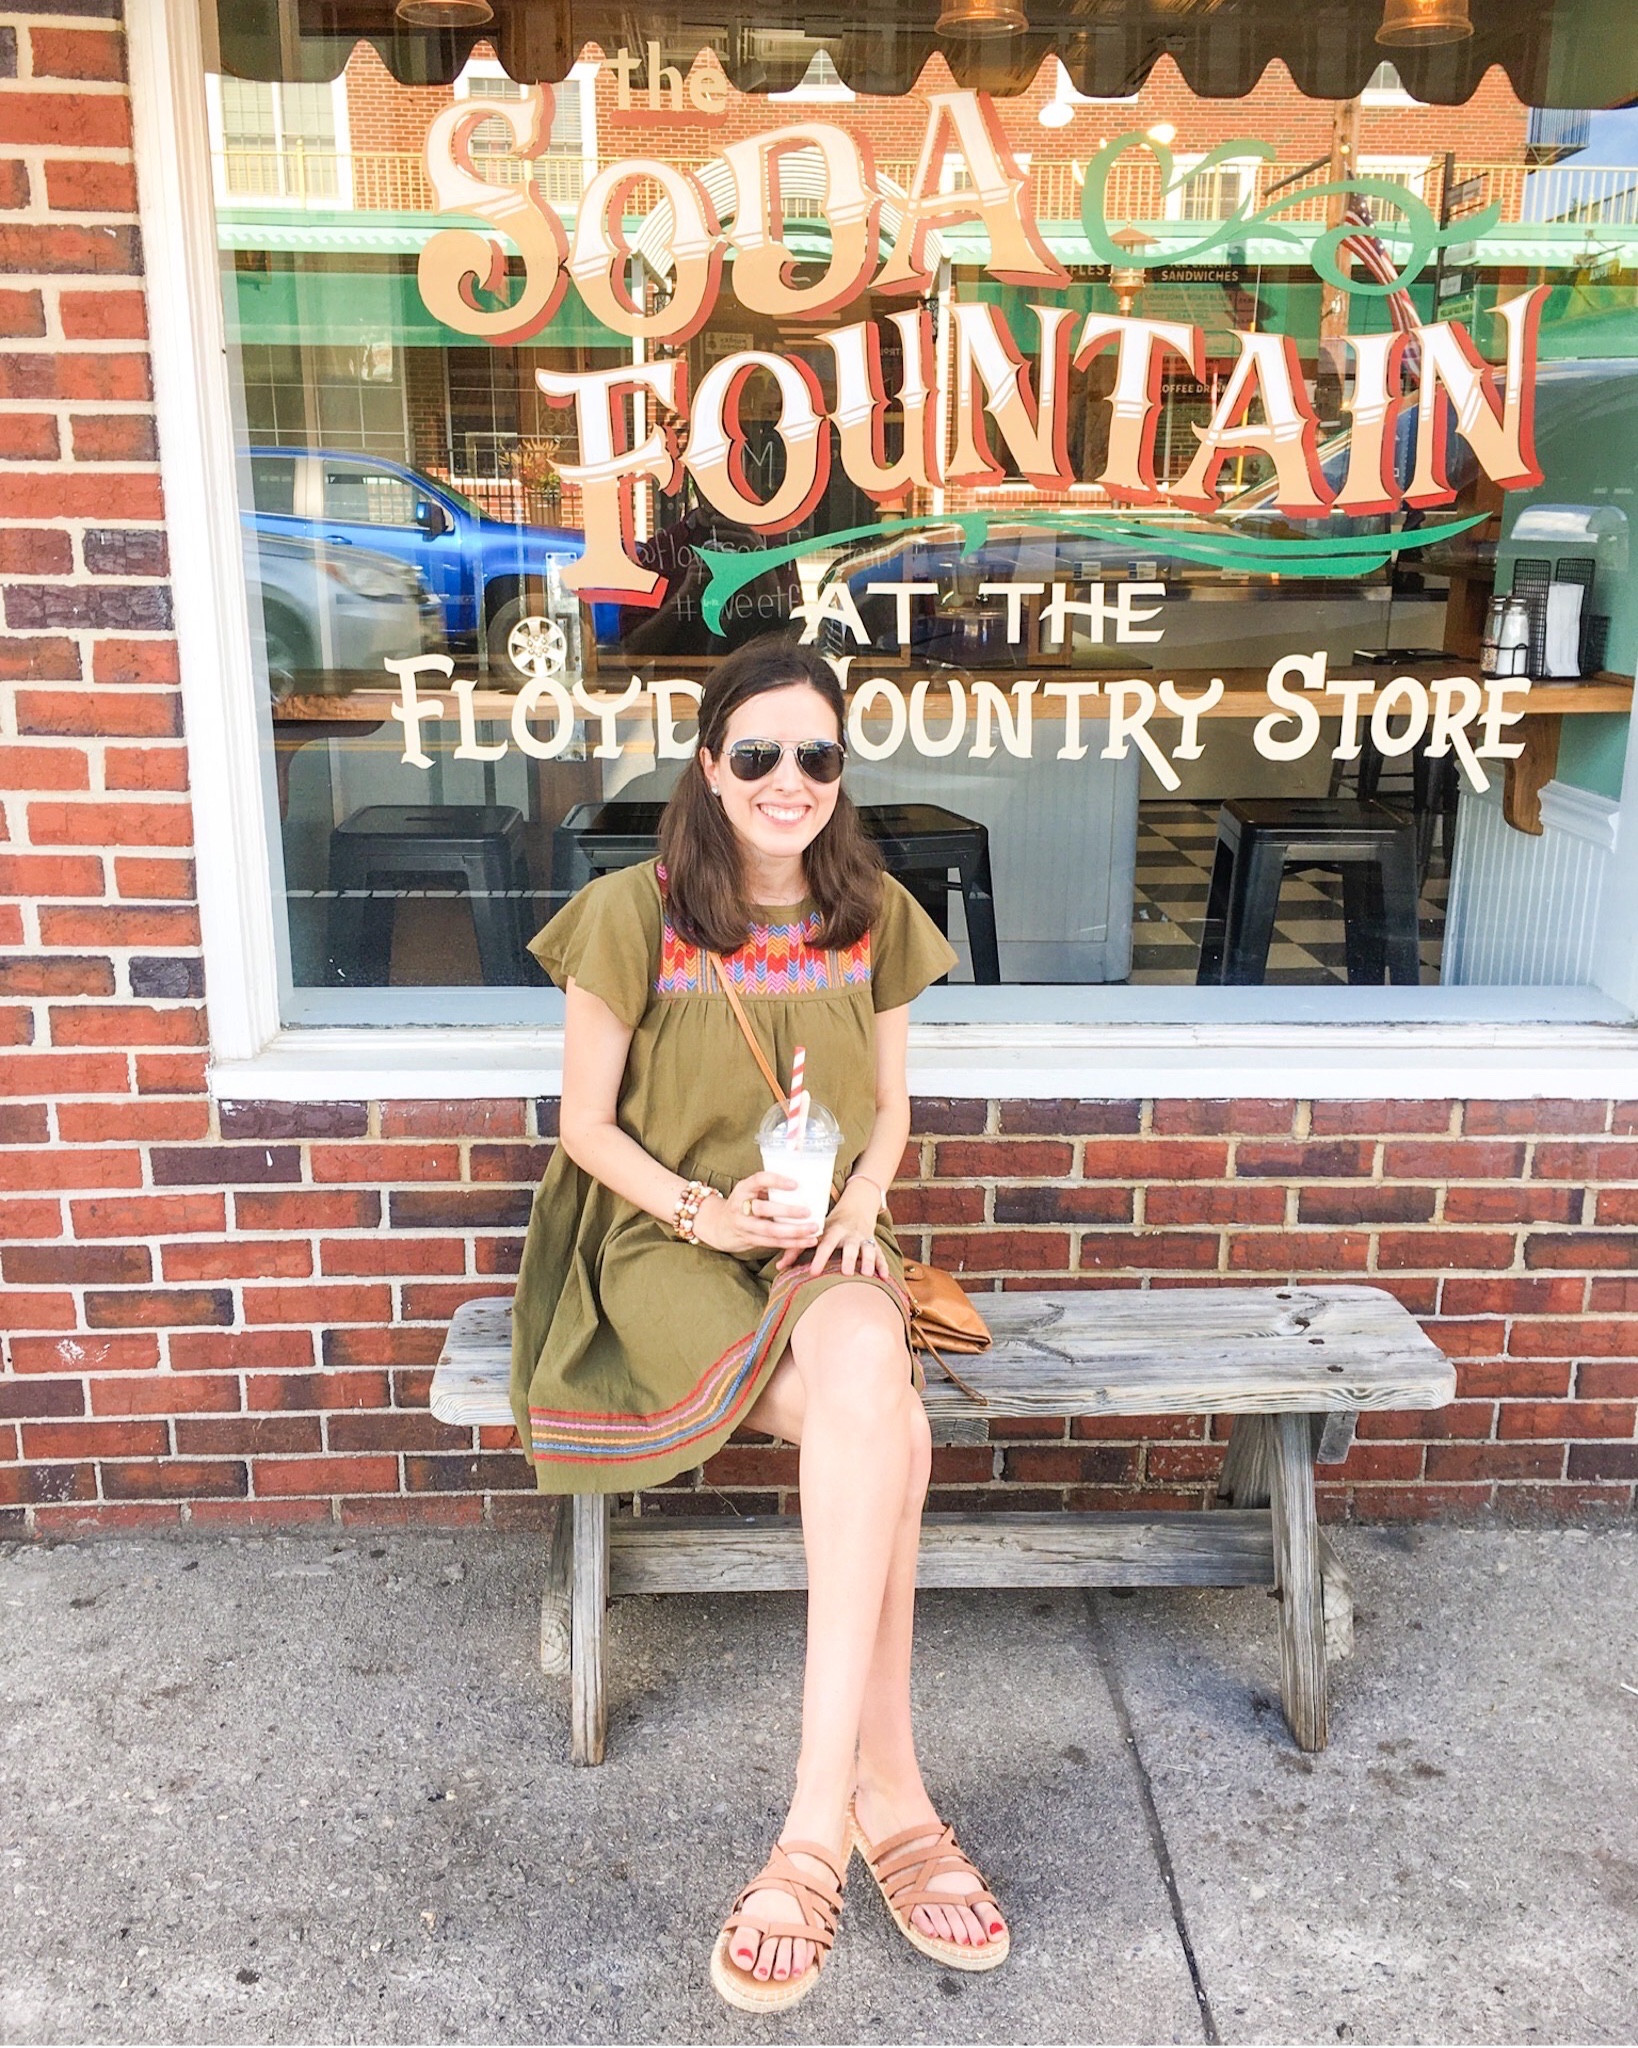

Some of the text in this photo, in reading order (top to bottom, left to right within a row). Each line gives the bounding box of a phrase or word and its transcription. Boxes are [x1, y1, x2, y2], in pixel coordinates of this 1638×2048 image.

[603, 40, 728, 115] the
[418, 82, 1073, 345] SODA
[1161, 270, 1239, 282] SANDWICHES
[1161, 384, 1194, 394] OFFEE
[535, 285, 1552, 608] FOUNTAIN
[789, 581, 1167, 645] AT THE
[820, 655, 1225, 791] OUNTRY
[1252, 651, 1533, 793] STORE
